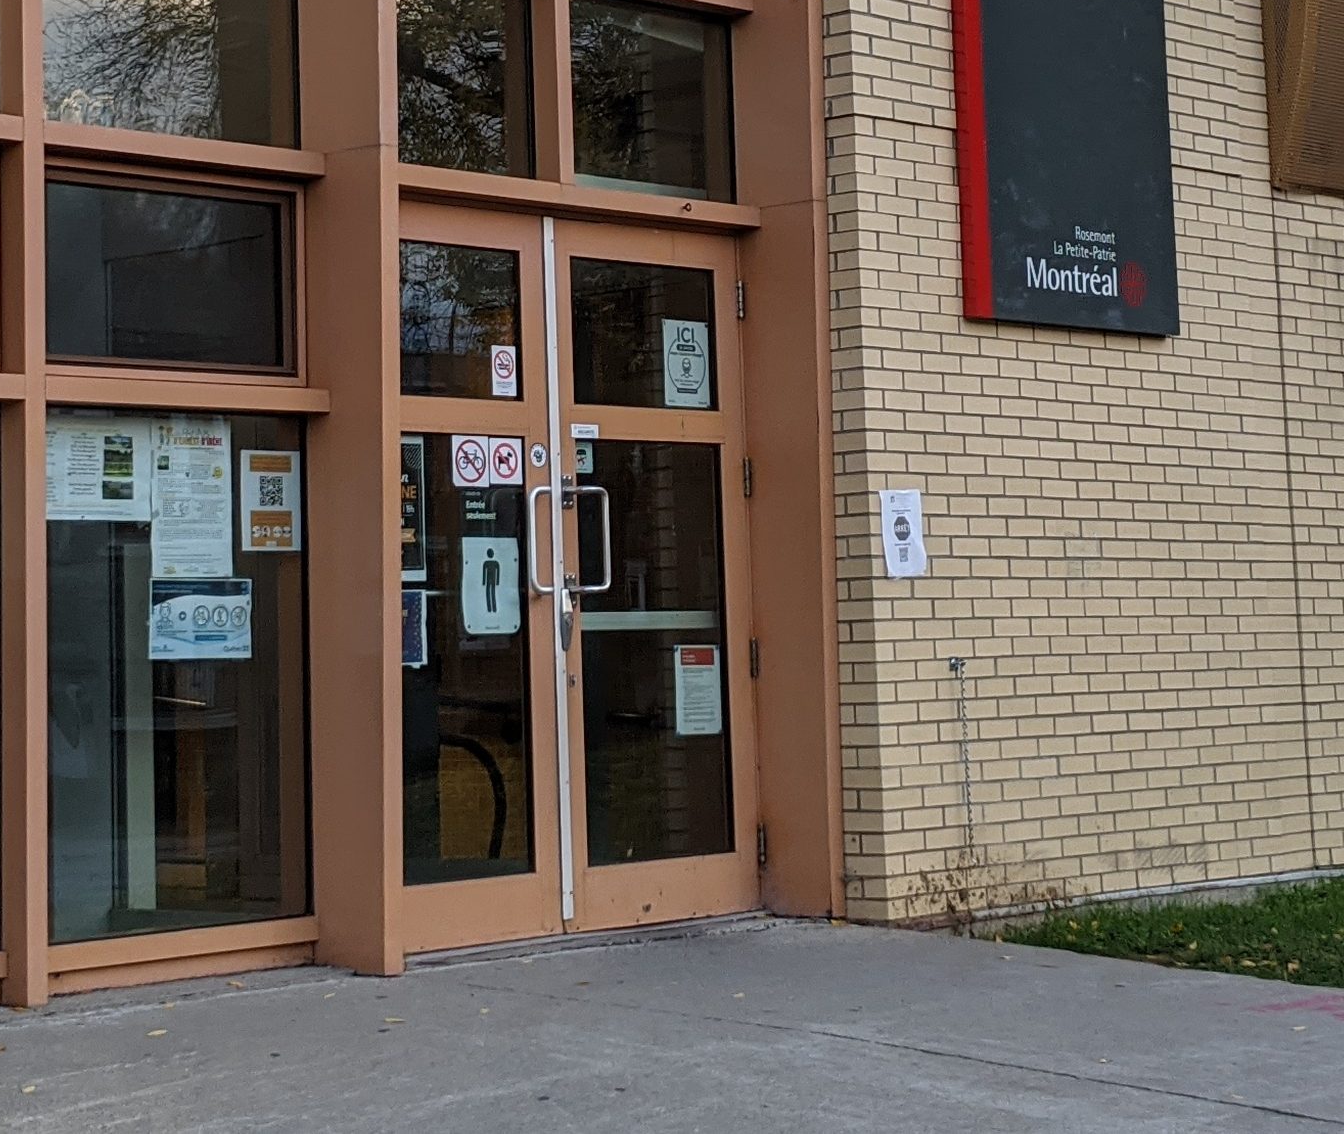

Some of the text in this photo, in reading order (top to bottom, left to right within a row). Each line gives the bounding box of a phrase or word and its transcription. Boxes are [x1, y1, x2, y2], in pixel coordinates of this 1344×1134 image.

[1075, 225, 1116, 245] Rosemont
[1053, 240, 1117, 262] La Petite-Patrie
[1026, 256, 1119, 297] Montréal
[677, 326, 695, 344] ICI
